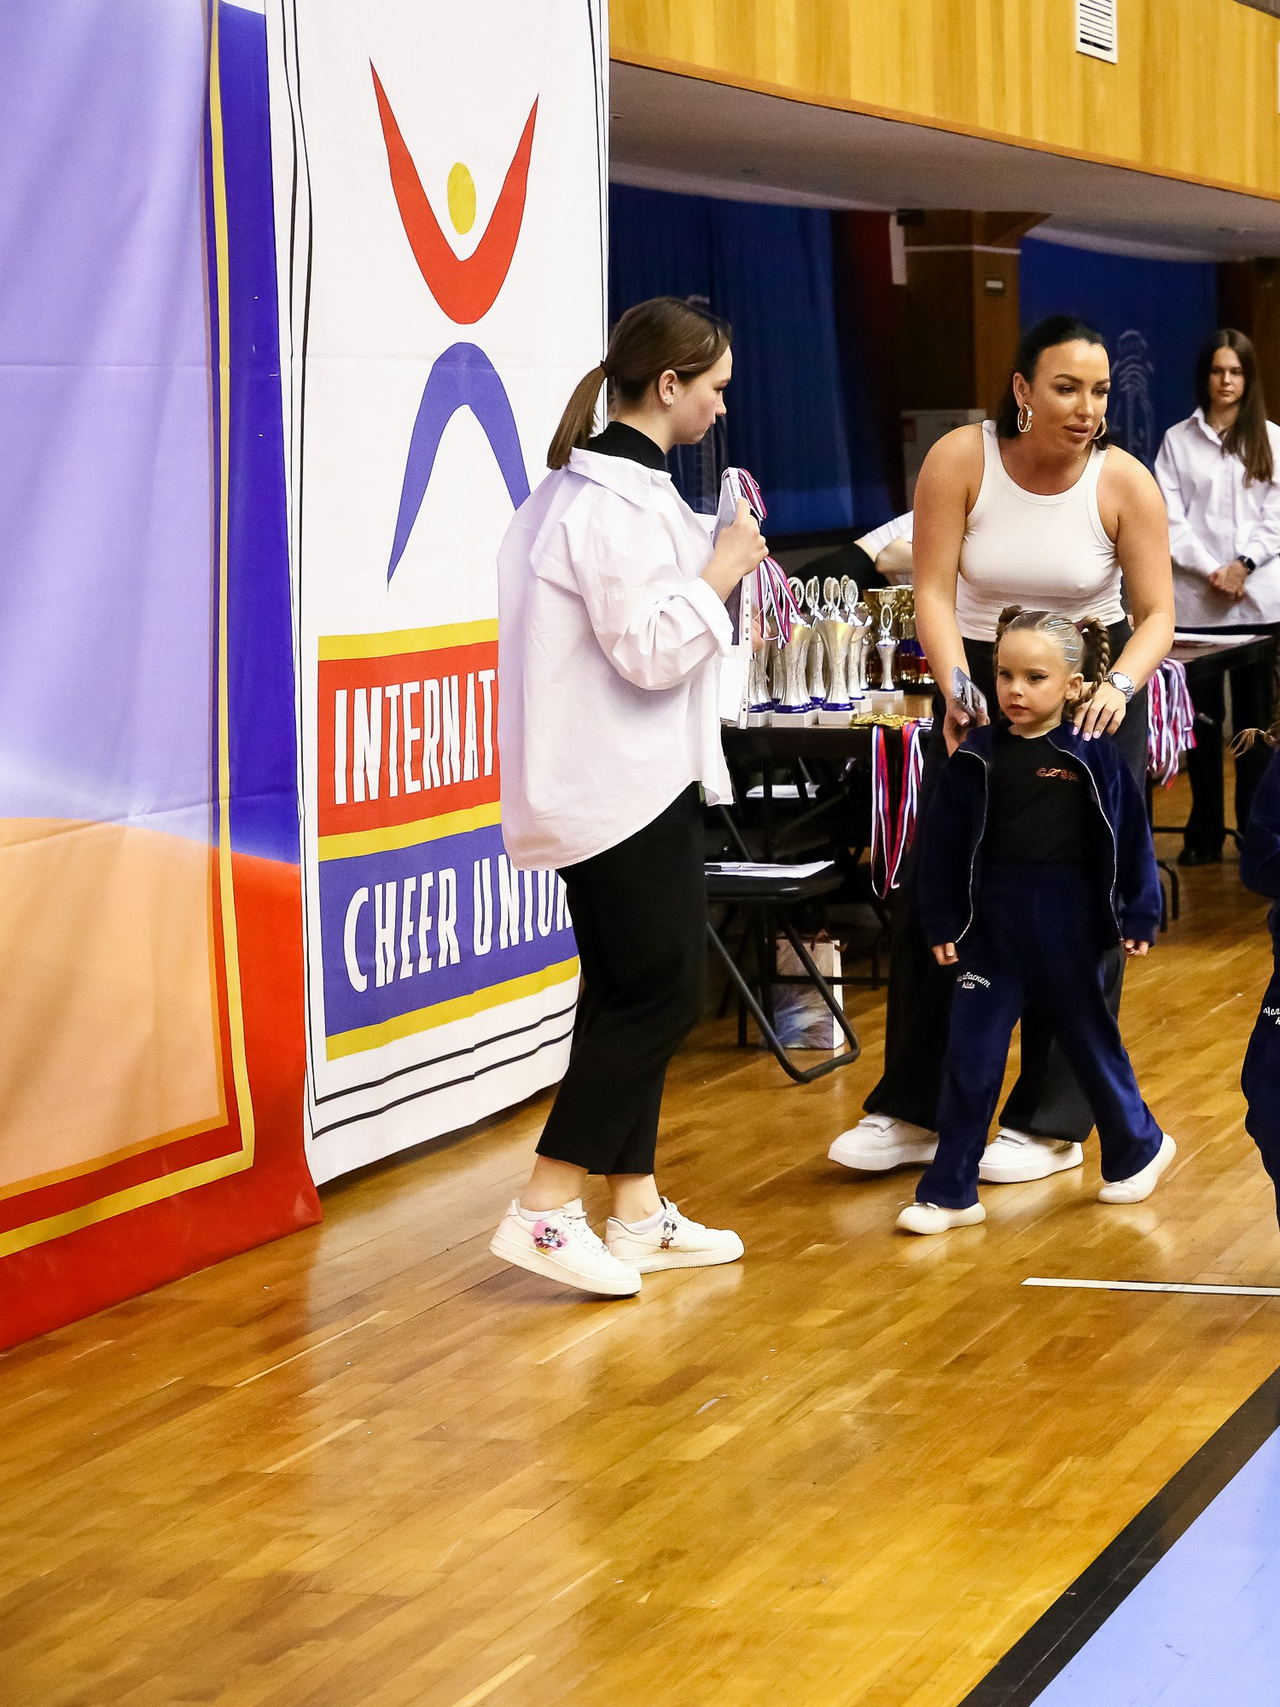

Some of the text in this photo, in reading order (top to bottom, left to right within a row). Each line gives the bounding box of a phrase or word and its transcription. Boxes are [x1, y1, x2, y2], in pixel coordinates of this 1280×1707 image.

[335, 669, 499, 804] INTERNAT
[343, 853, 573, 993] CHEER UNION
